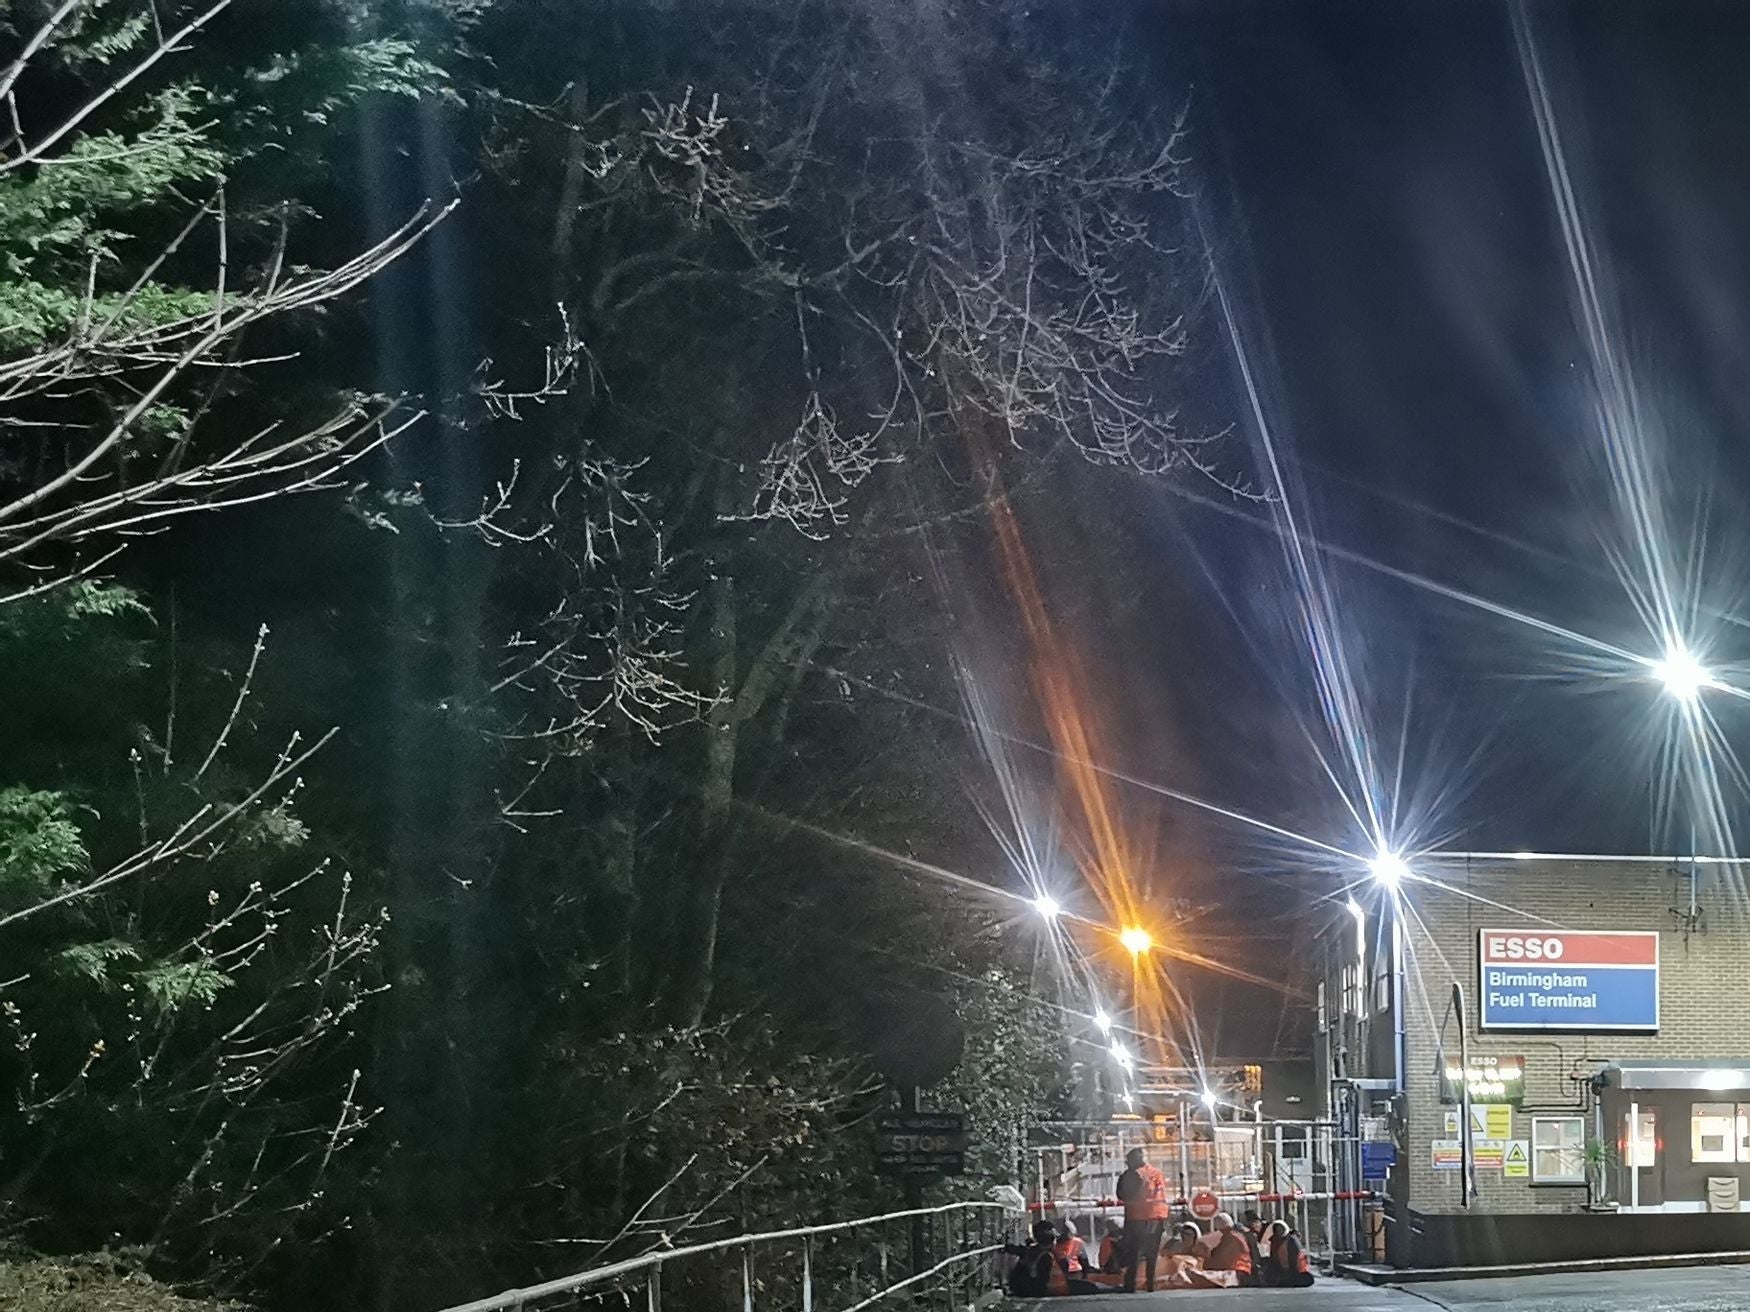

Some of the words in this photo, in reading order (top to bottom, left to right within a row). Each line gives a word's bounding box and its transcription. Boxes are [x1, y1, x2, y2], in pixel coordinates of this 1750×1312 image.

[1489, 937, 1564, 959] ESSO
[1490, 972, 1588, 990] Birmingham
[1490, 992, 1524, 1007] Fuel
[1528, 993, 1597, 1008] Terminal
[1470, 1056, 1498, 1066] ESSO
[890, 1134, 950, 1153] STOP
